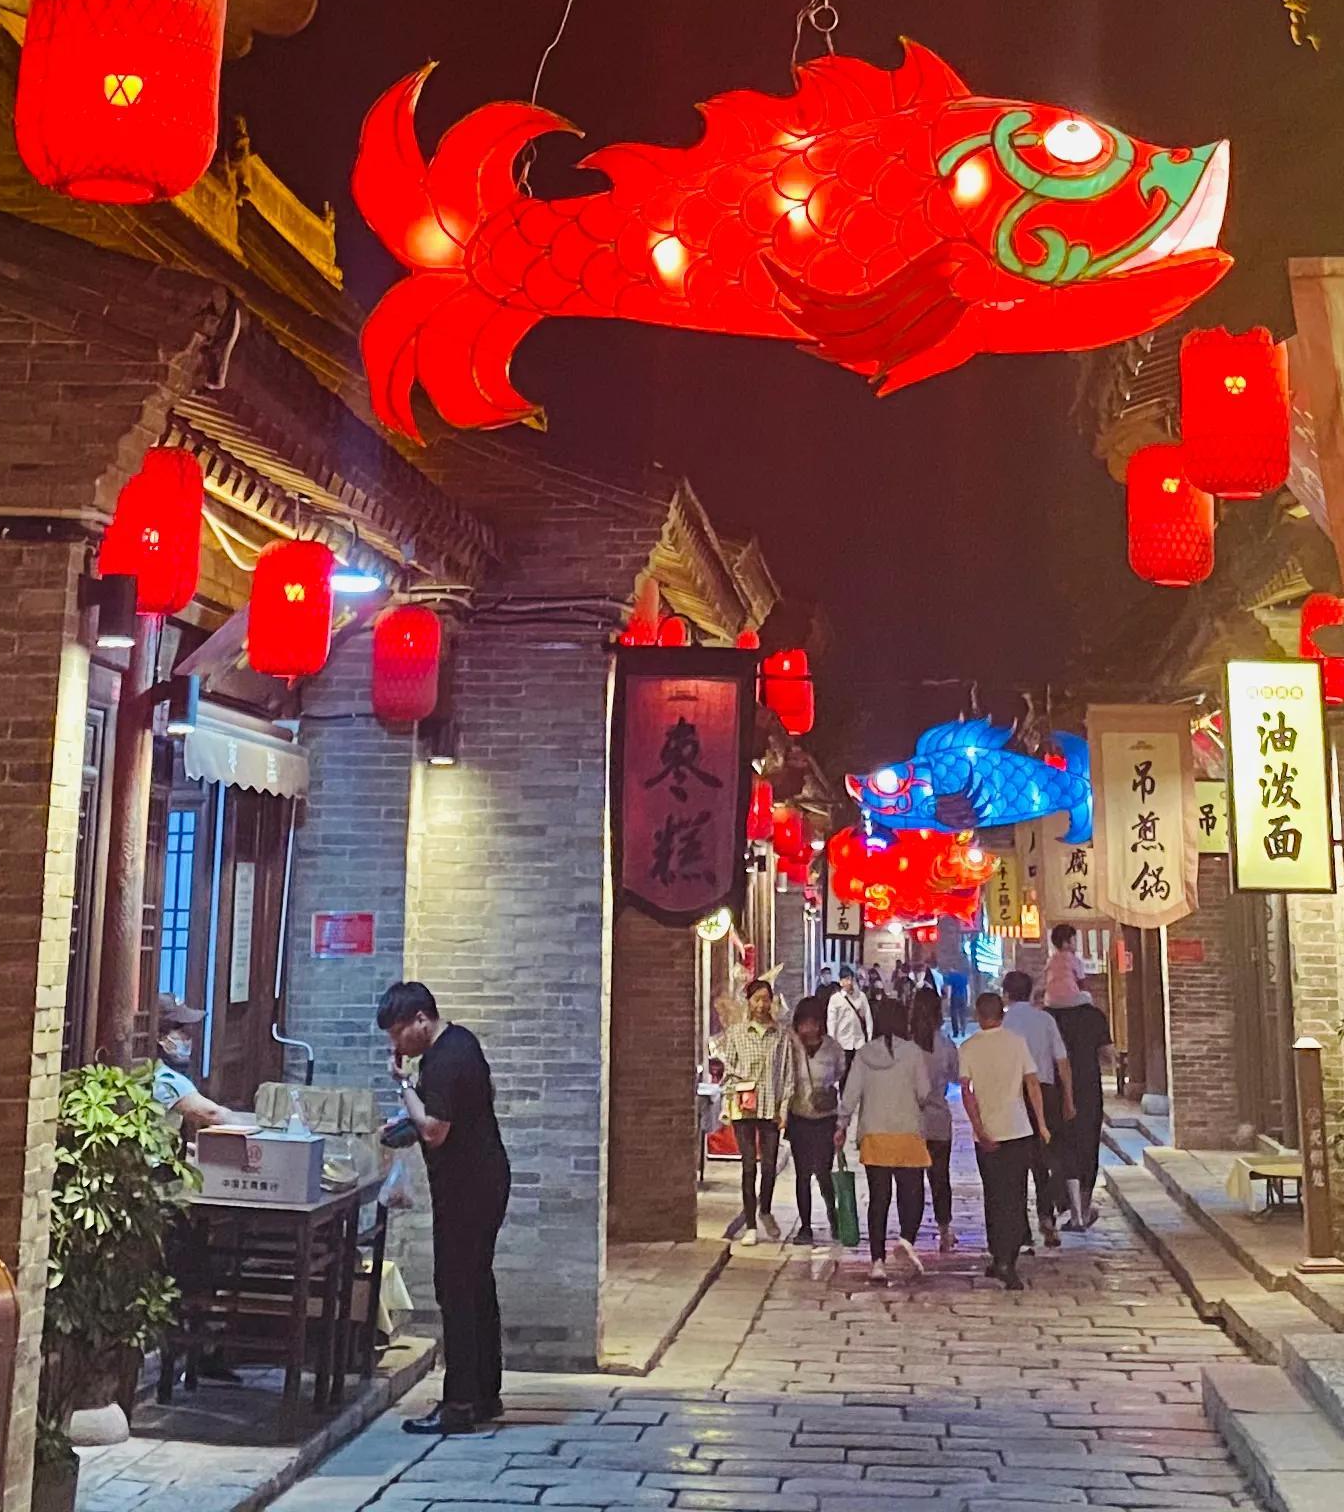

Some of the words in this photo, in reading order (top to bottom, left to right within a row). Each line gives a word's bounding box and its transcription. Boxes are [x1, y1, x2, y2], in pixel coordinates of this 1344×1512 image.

[1256, 710, 1303, 862] 油泼面
[1065, 842, 1093, 910] 腐皮
